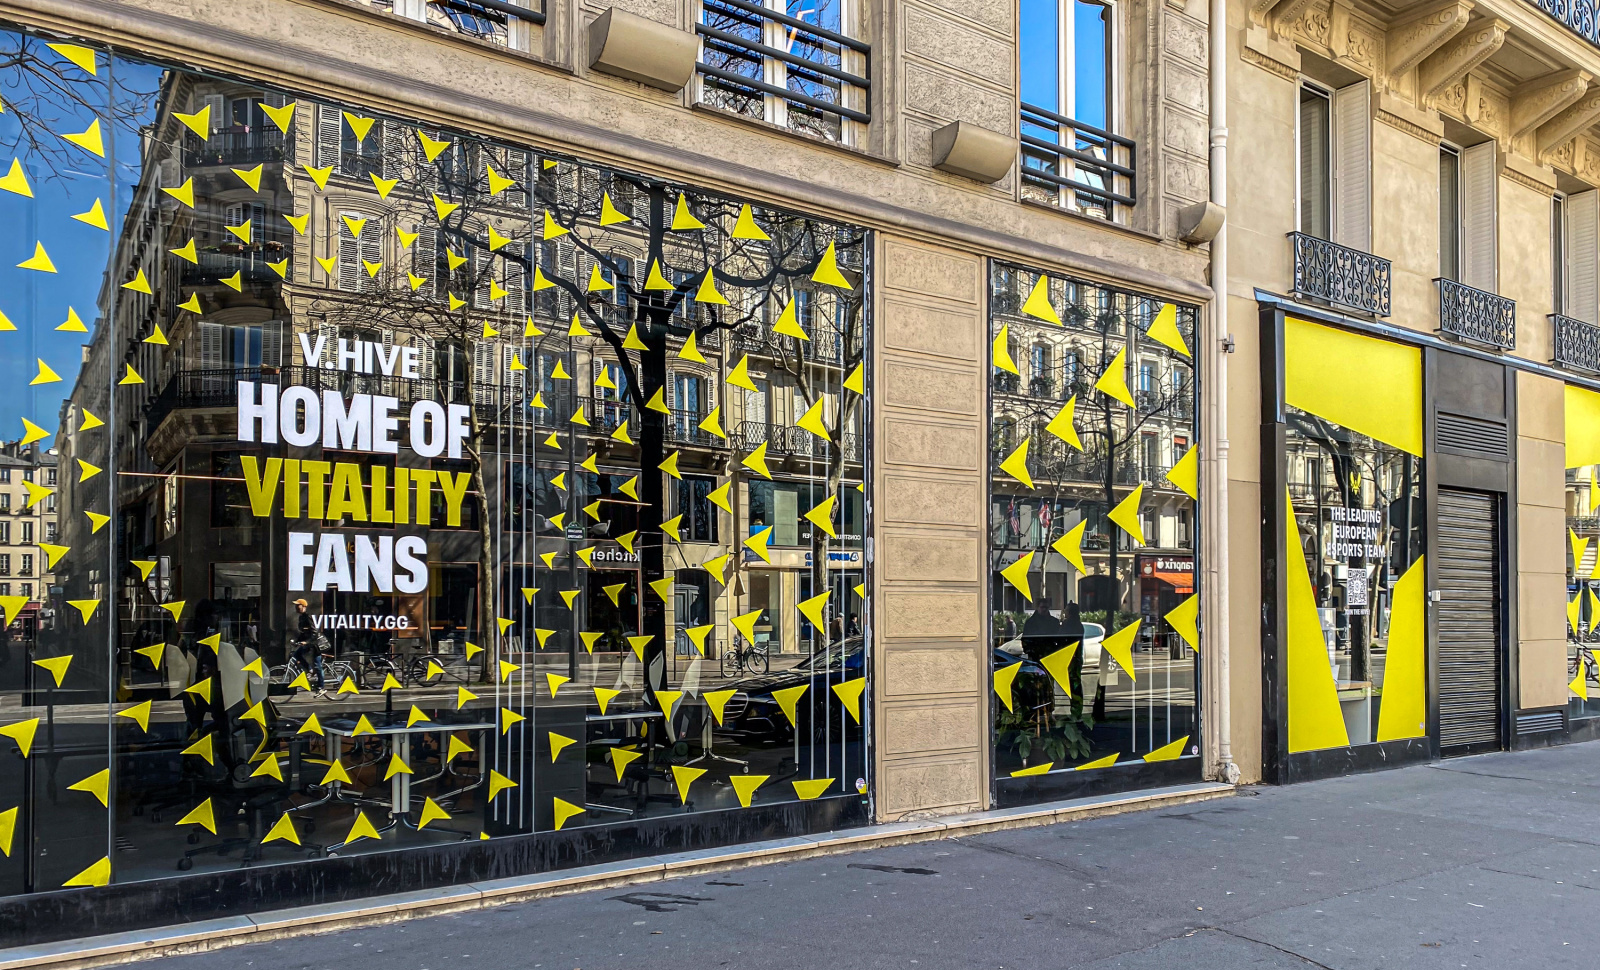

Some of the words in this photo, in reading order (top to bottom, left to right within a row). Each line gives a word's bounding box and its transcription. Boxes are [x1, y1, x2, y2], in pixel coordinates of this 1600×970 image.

[298, 332, 420, 380] V.HIVE
[237, 380, 399, 454] HOME
[409, 400, 471, 459] OF
[239, 455, 472, 527] VITALITY
[1331, 507, 1346, 521] THE
[1347, 508, 1381, 523] LEADING
[1335, 525, 1378, 540] EUROPEAN
[288, 532, 429, 594] FANS
[1326, 542, 1363, 558] ESPORTS
[1364, 544, 1386, 558] TEAM
[311, 614, 409, 630] VITALITY.GG
